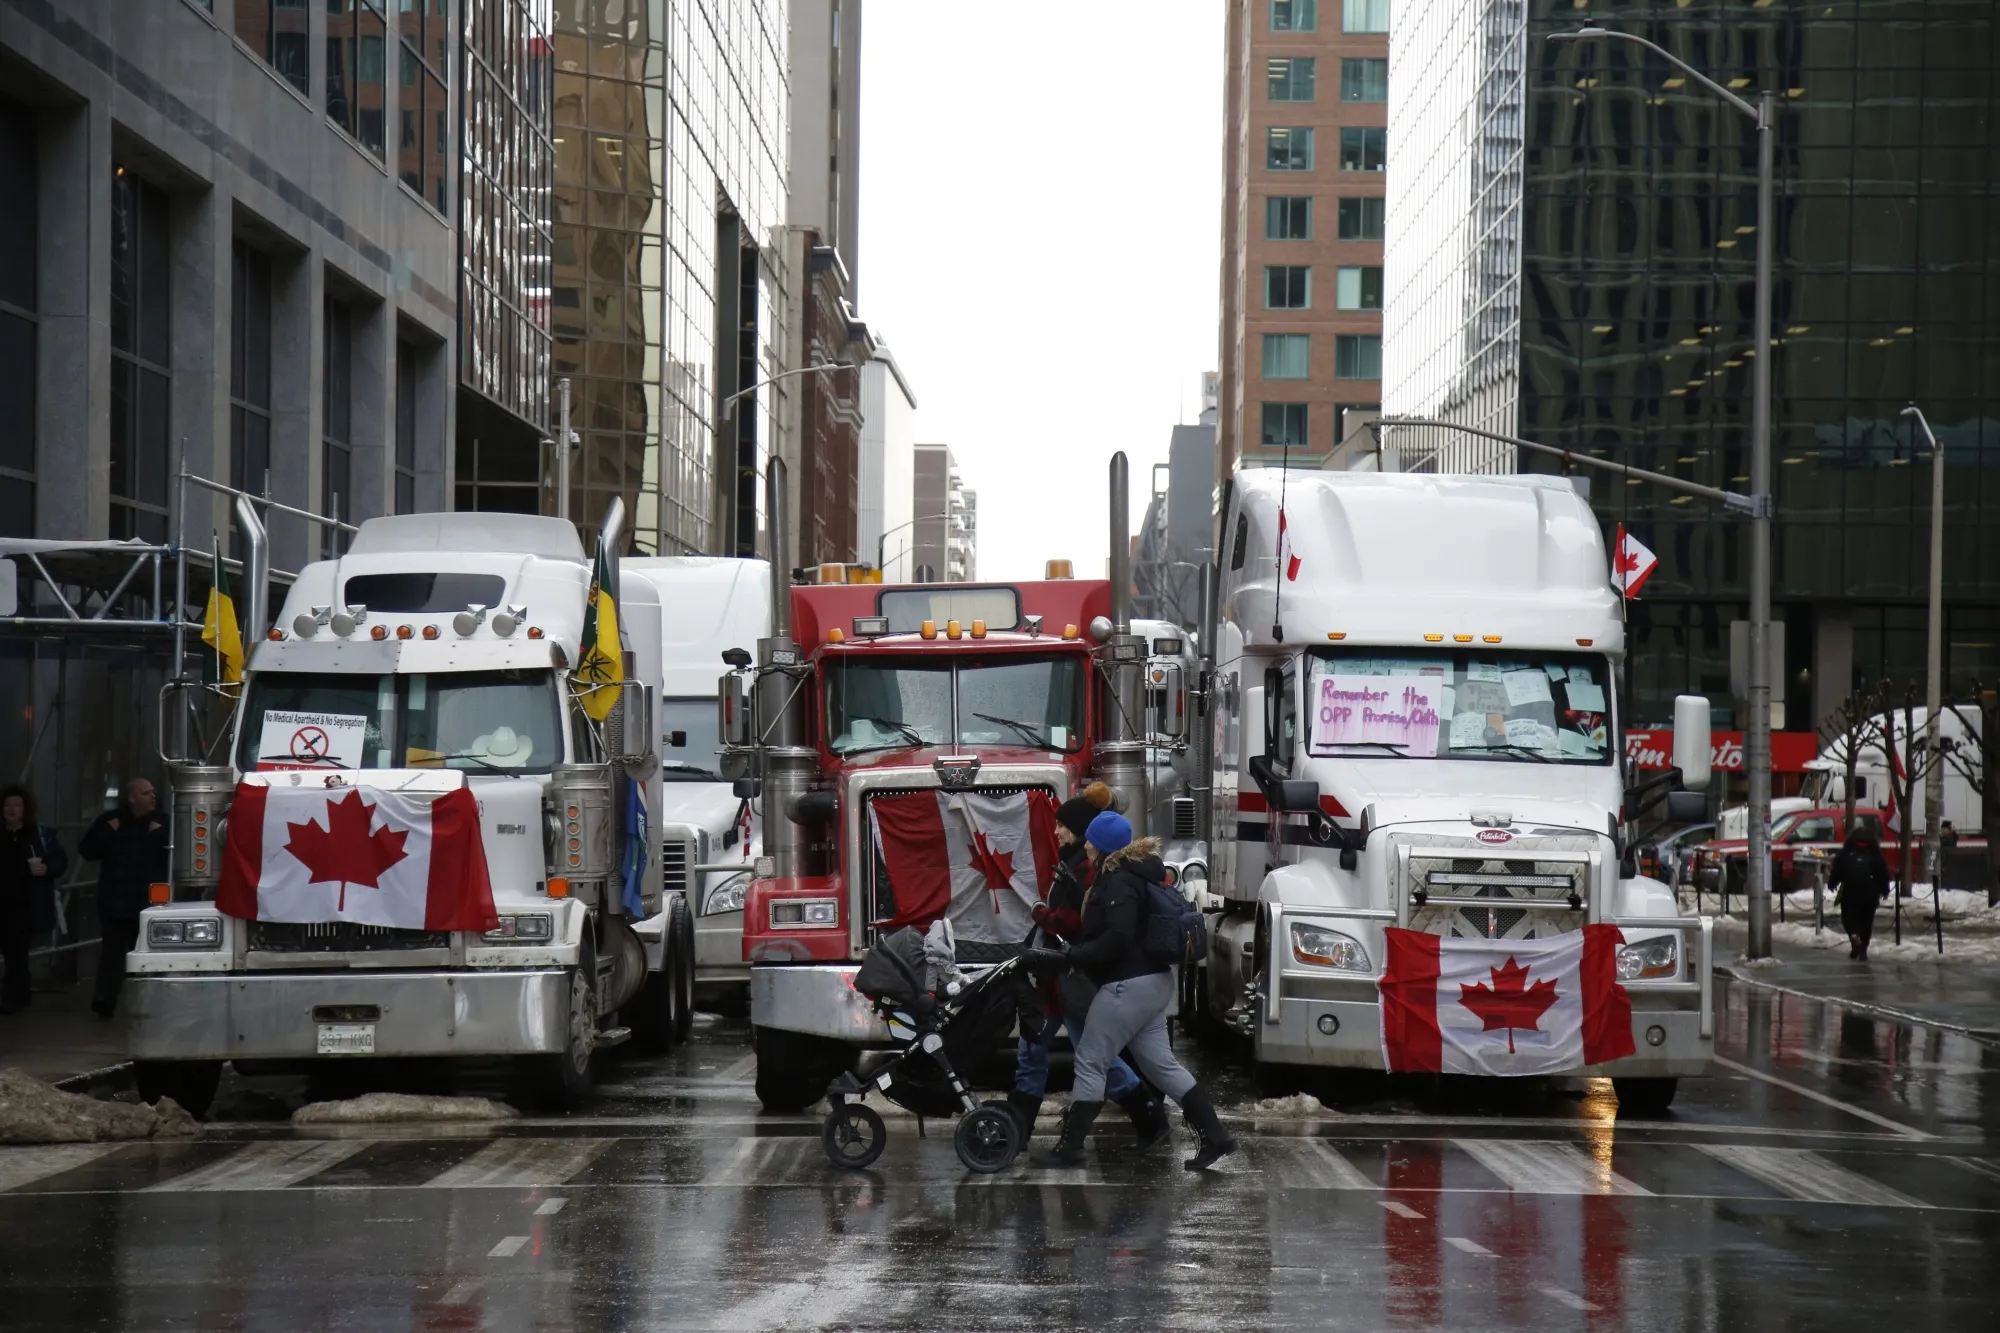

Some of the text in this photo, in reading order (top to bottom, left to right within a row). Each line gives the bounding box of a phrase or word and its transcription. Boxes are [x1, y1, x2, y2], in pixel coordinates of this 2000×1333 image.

[1402, 686, 1428, 706] the
[265, 713, 273, 722] No
[273, 713, 294, 724] Medical
[294, 714, 320, 725] Apartheid
[325, 716, 334, 726] No
[333, 716, 365, 729] Segregation
[1320, 706, 1352, 724] OPP
[1626, 734, 1665, 767] Tim
